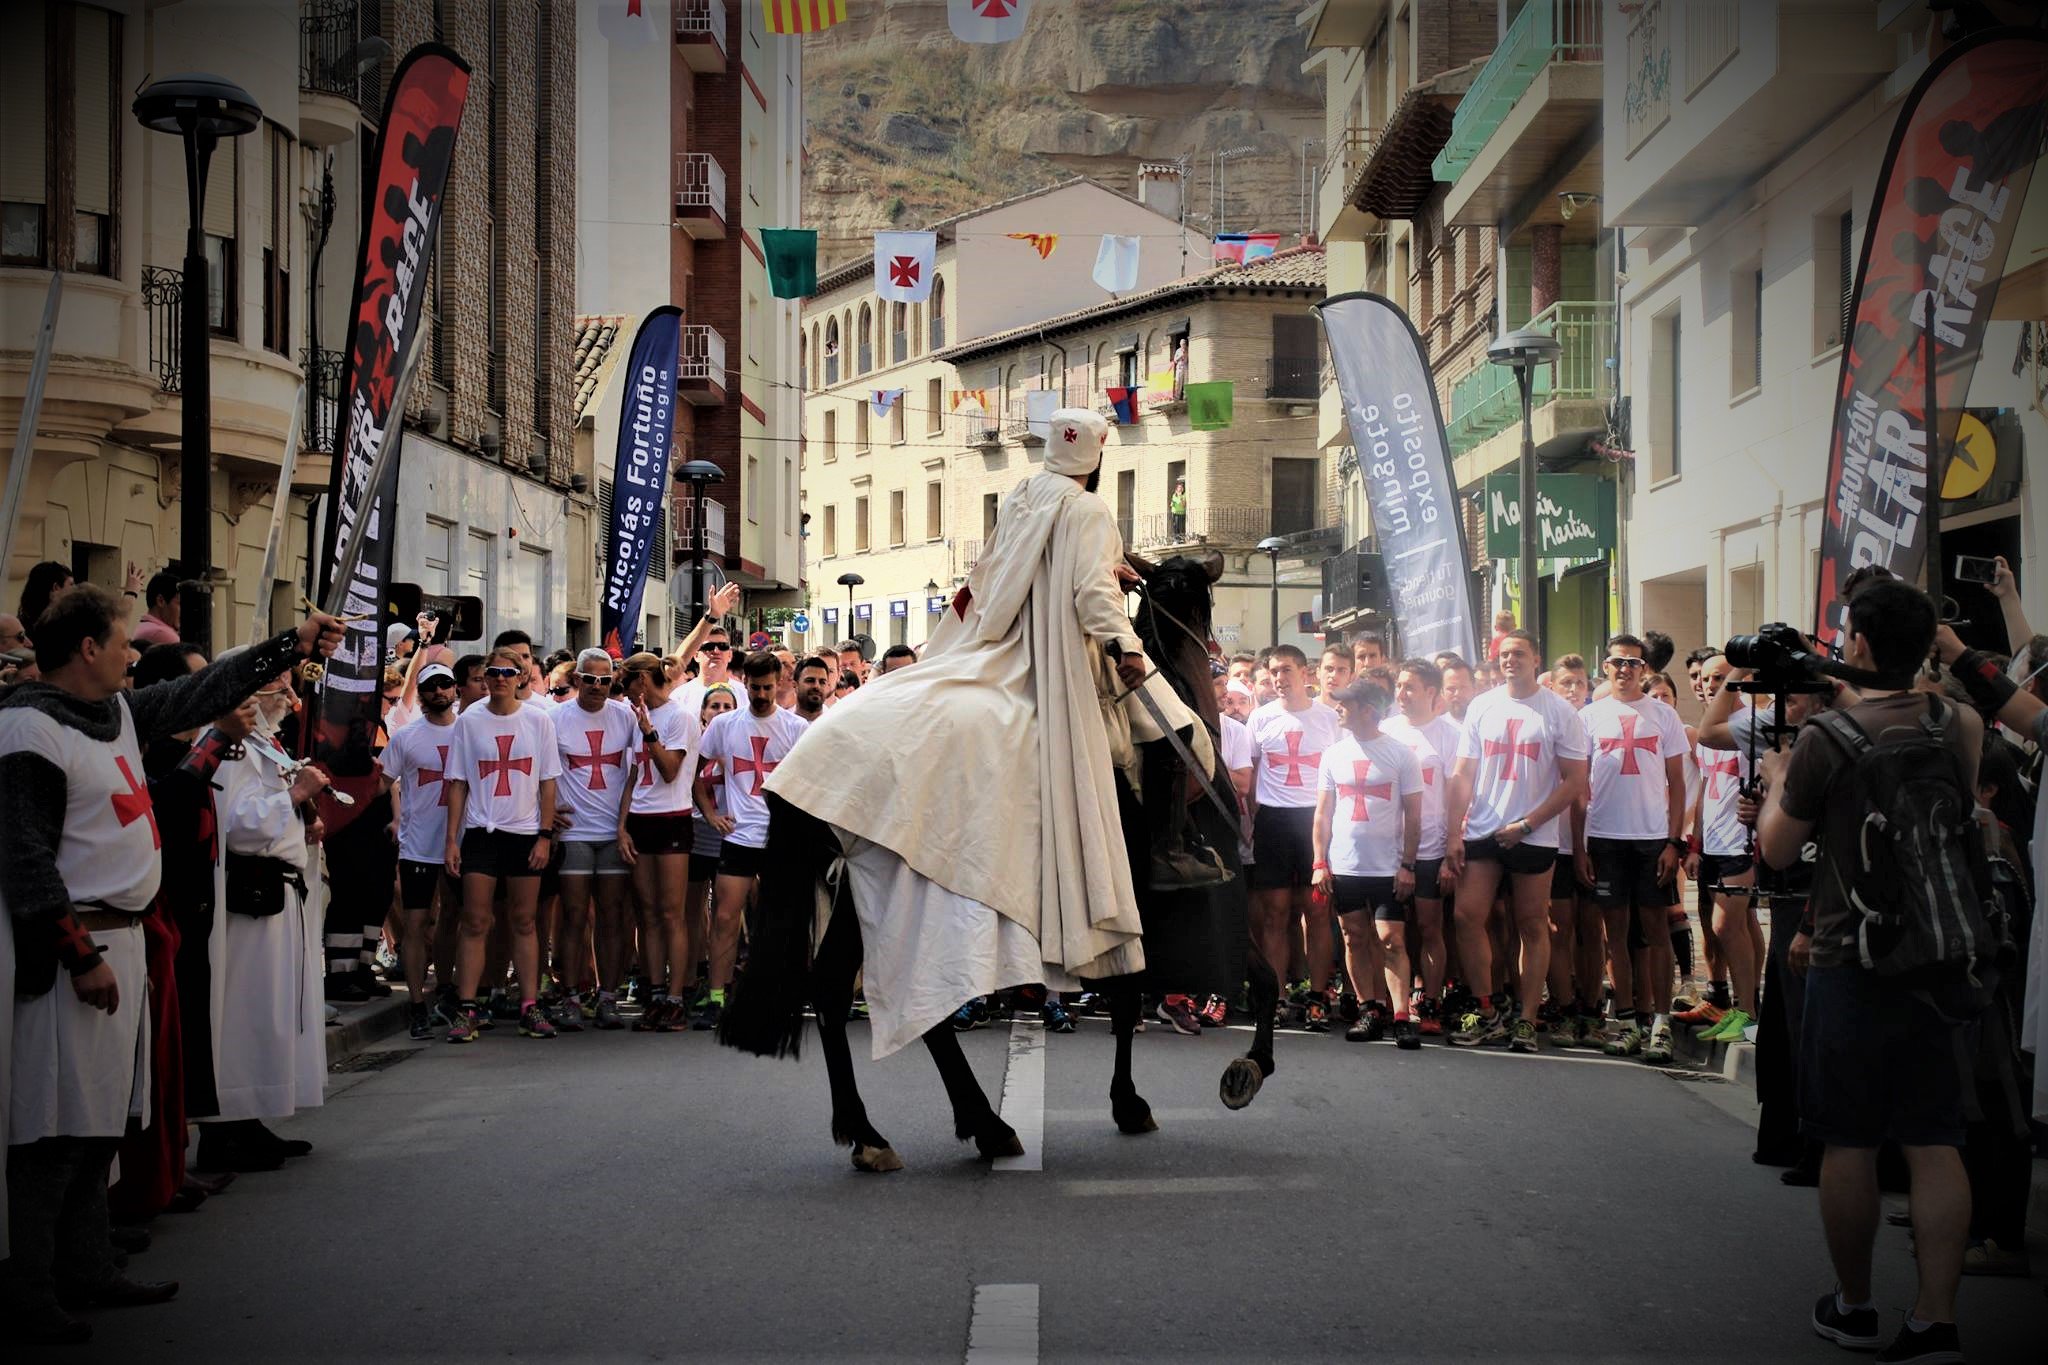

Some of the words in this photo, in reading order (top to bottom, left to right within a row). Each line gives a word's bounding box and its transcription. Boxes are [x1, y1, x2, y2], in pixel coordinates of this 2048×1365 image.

[385, 176, 433, 353] RACE
[1909, 165, 2010, 348] RACE
[608, 495, 641, 610] Nicolás
[627, 365, 656, 486] Fortuño
[621, 539, 645, 613] centro
[642, 501, 654, 526] de
[650, 370, 669, 489] podología
[1838, 390, 1879, 530] MONZÓN
